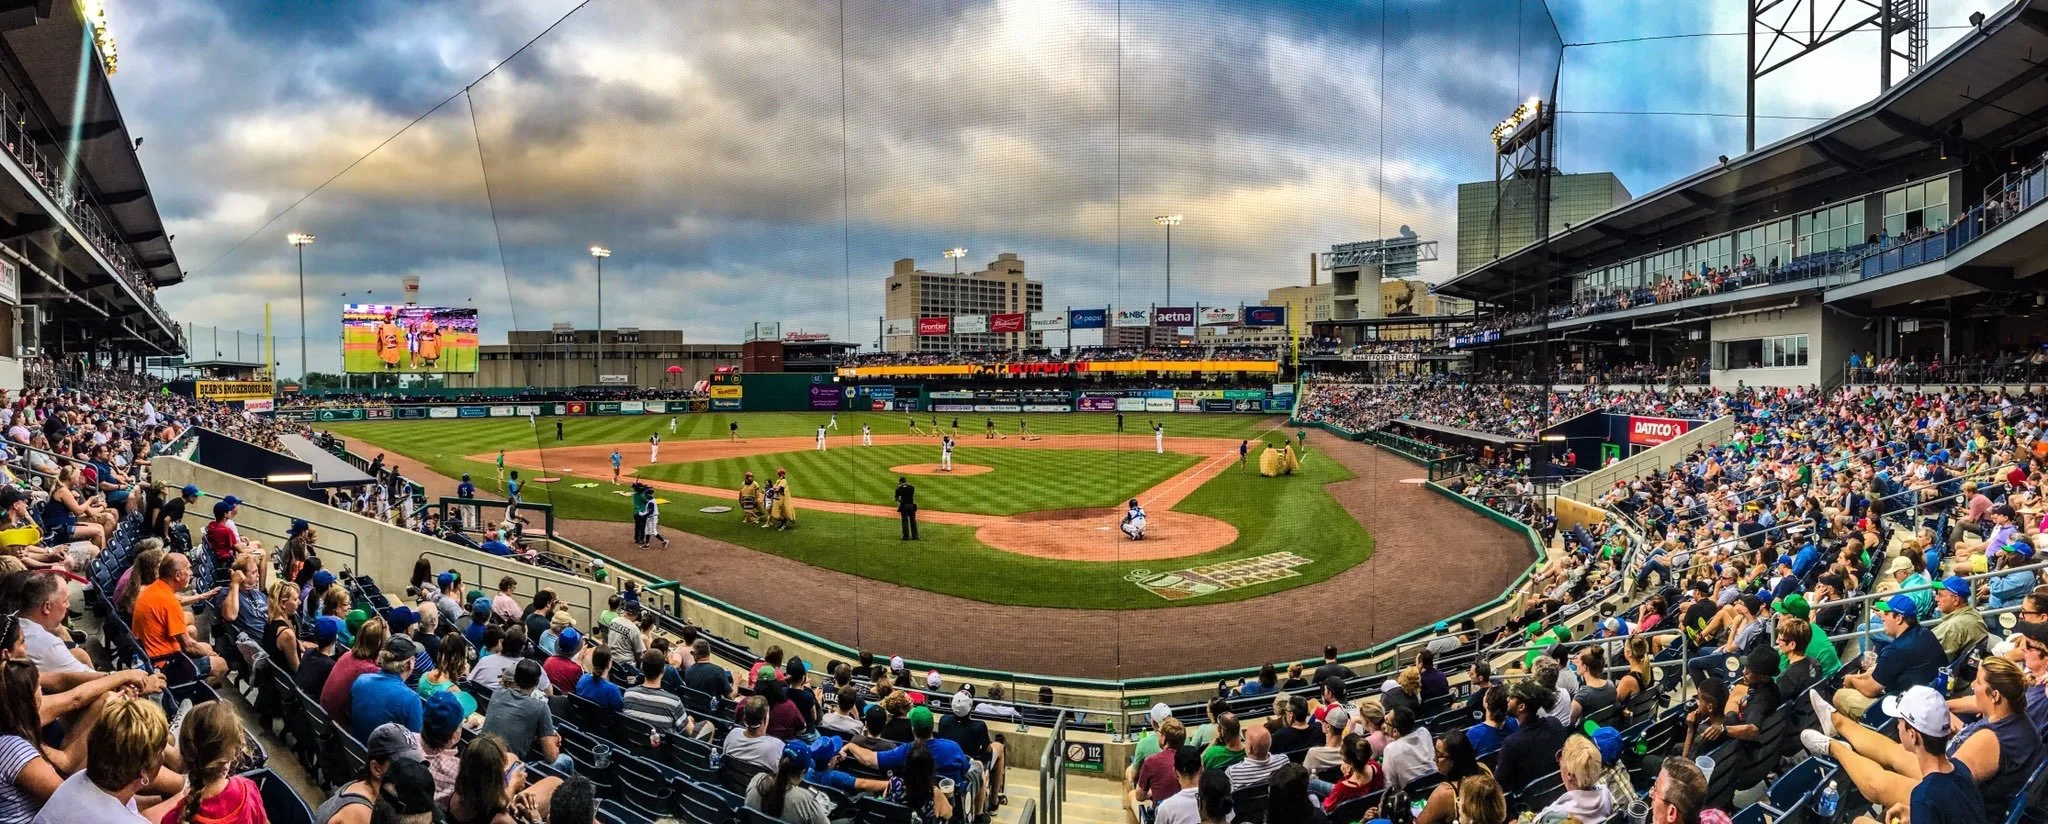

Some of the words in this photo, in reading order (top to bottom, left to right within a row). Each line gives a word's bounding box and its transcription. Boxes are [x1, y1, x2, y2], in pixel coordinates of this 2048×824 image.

[1129, 311, 1146, 319] NBC
[1158, 312, 1191, 322] aetna
[920, 322, 948, 330] Frontier
[785, 331, 829, 340] Budweiser
[200, 384, 223, 395] BEAR'S
[223, 384, 261, 395] SMOKEHOUSE
[262, 384, 273, 395] BBQ
[1635, 422, 1671, 436] DATTCO
[1088, 746, 1101, 758] 112
